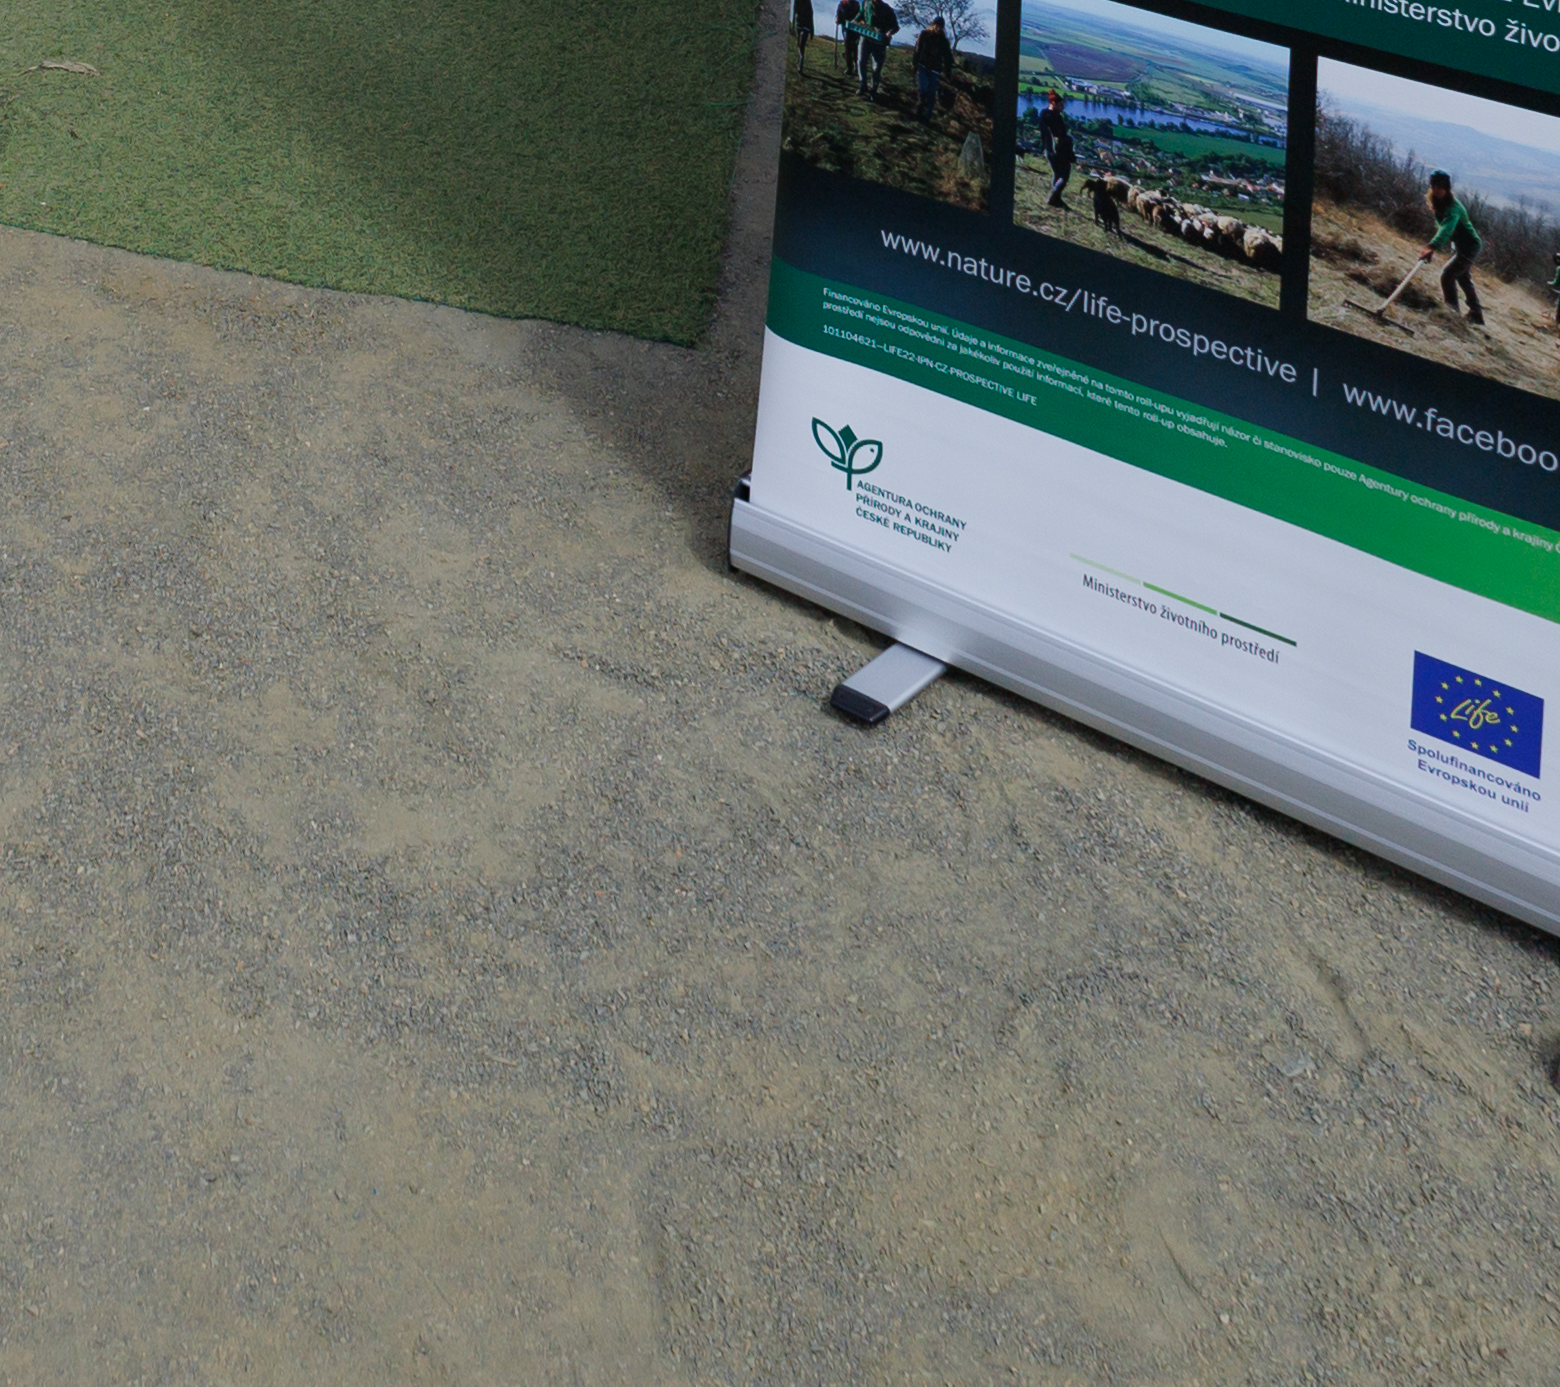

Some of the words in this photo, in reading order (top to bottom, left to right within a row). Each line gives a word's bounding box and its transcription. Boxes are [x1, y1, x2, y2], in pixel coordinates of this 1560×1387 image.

[880, 229, 1298, 383] www.nature.cz/life-prospective
[1016, 385, 1038, 407] LIFE
[855, 505, 890, 529] ČESKÉ
[893, 521, 952, 553] REPUBLIKY
[856, 491, 902, 519] PŘÍRODY
[904, 512, 912, 524] A
[914, 515, 960, 543] KRAJINY
[857, 479, 913, 510] AGENTURA
[914, 501, 967, 531] OCHRANY
[1082, 573, 1157, 615] Ministerstvo
[1159, 604, 1218, 640] životního
[1221, 632, 1280, 665] prostředí
[1450, 698, 1501, 729] Life
[1407, 738, 1542, 802] Spolufinancováno
[1417, 758, 1497, 800] Evropskou
